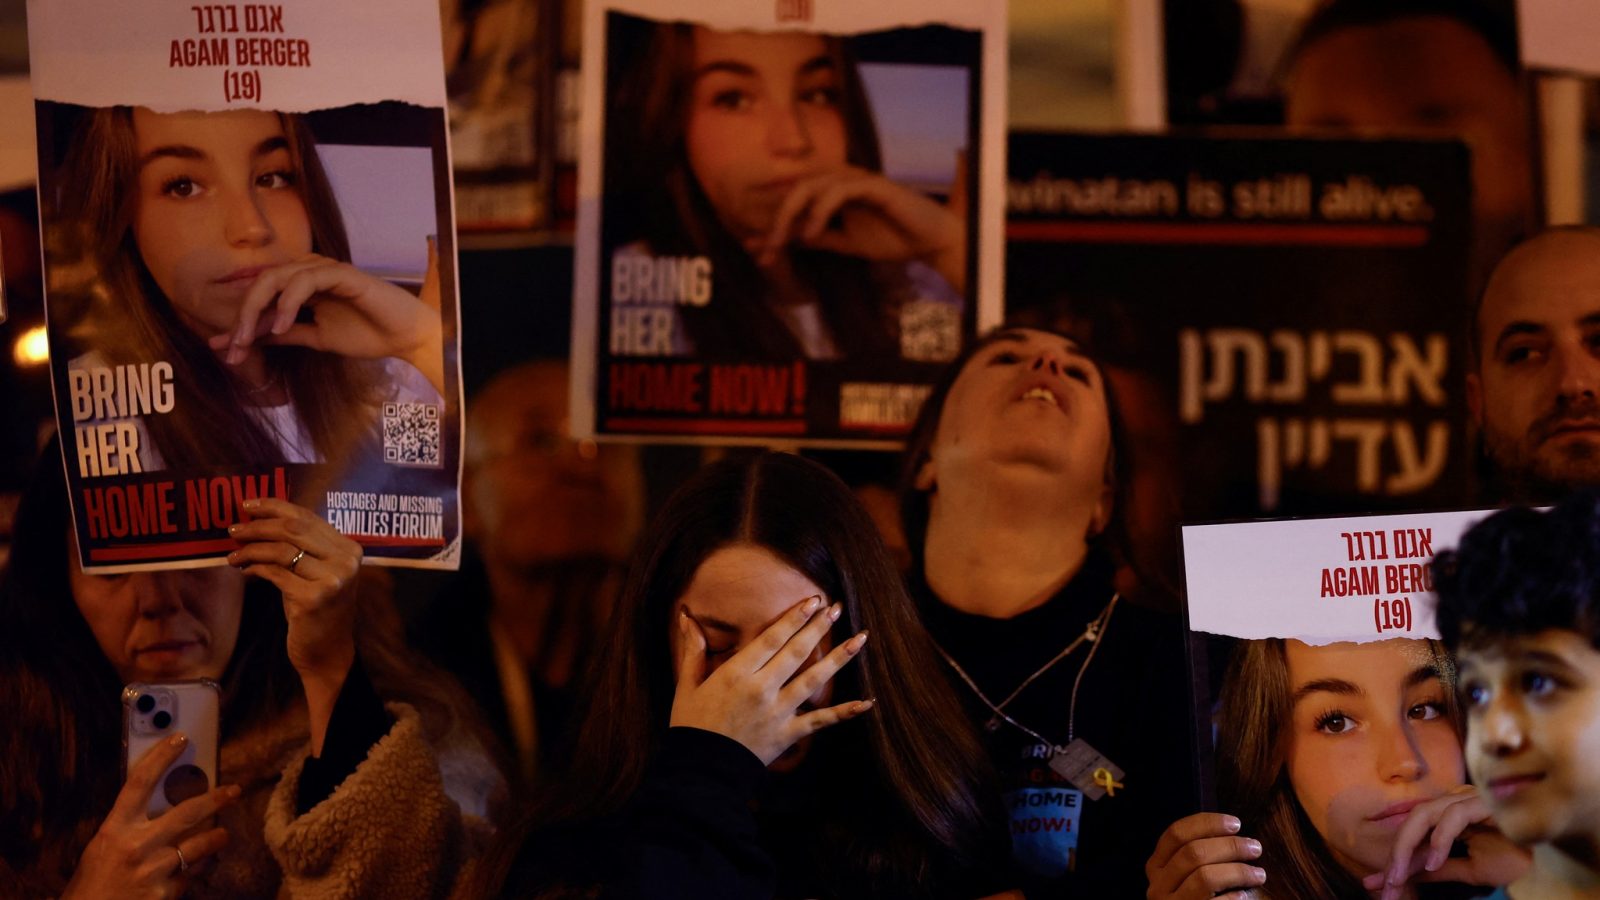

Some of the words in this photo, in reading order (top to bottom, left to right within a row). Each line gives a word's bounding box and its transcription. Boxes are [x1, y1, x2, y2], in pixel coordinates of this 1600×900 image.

[192, 5, 239, 33] ברגר
[245, 5, 284, 33] אגם
[170, 38, 229, 67] AGAM
[235, 38, 311, 67] BERGER
[224, 69, 261, 102] (19)
[1007, 172, 1178, 217] vinatan
[1186, 172, 1224, 218] is
[1231, 173, 1311, 218] still
[1319, 174, 1435, 222] alive.
[611, 253, 715, 307] BRING
[610, 306, 674, 356] HER
[68, 361, 175, 422] BRING
[709, 358, 806, 416] NOW!
[1177, 325, 1451, 424] אבינתן
[75, 423, 143, 479] HER
[1256, 416, 1451, 510] עדיין
[82, 480, 178, 540] HOME
[326, 491, 377, 511] HOSTAGES
[378, 493, 398, 512] AND
[400, 494, 443, 514] MISSING
[327, 508, 390, 537] FAMILIES
[391, 511, 443, 540] FORUM
[1341, 530, 1389, 561] ברגר
[1393, 528, 1434, 559] אגם
[1321, 566, 1380, 598] AGAM
[1385, 563, 1436, 594] BERG
[1374, 597, 1412, 633] (19)
[1014, 792, 1077, 808] HOME
[1013, 816, 1071, 834] NOW!
